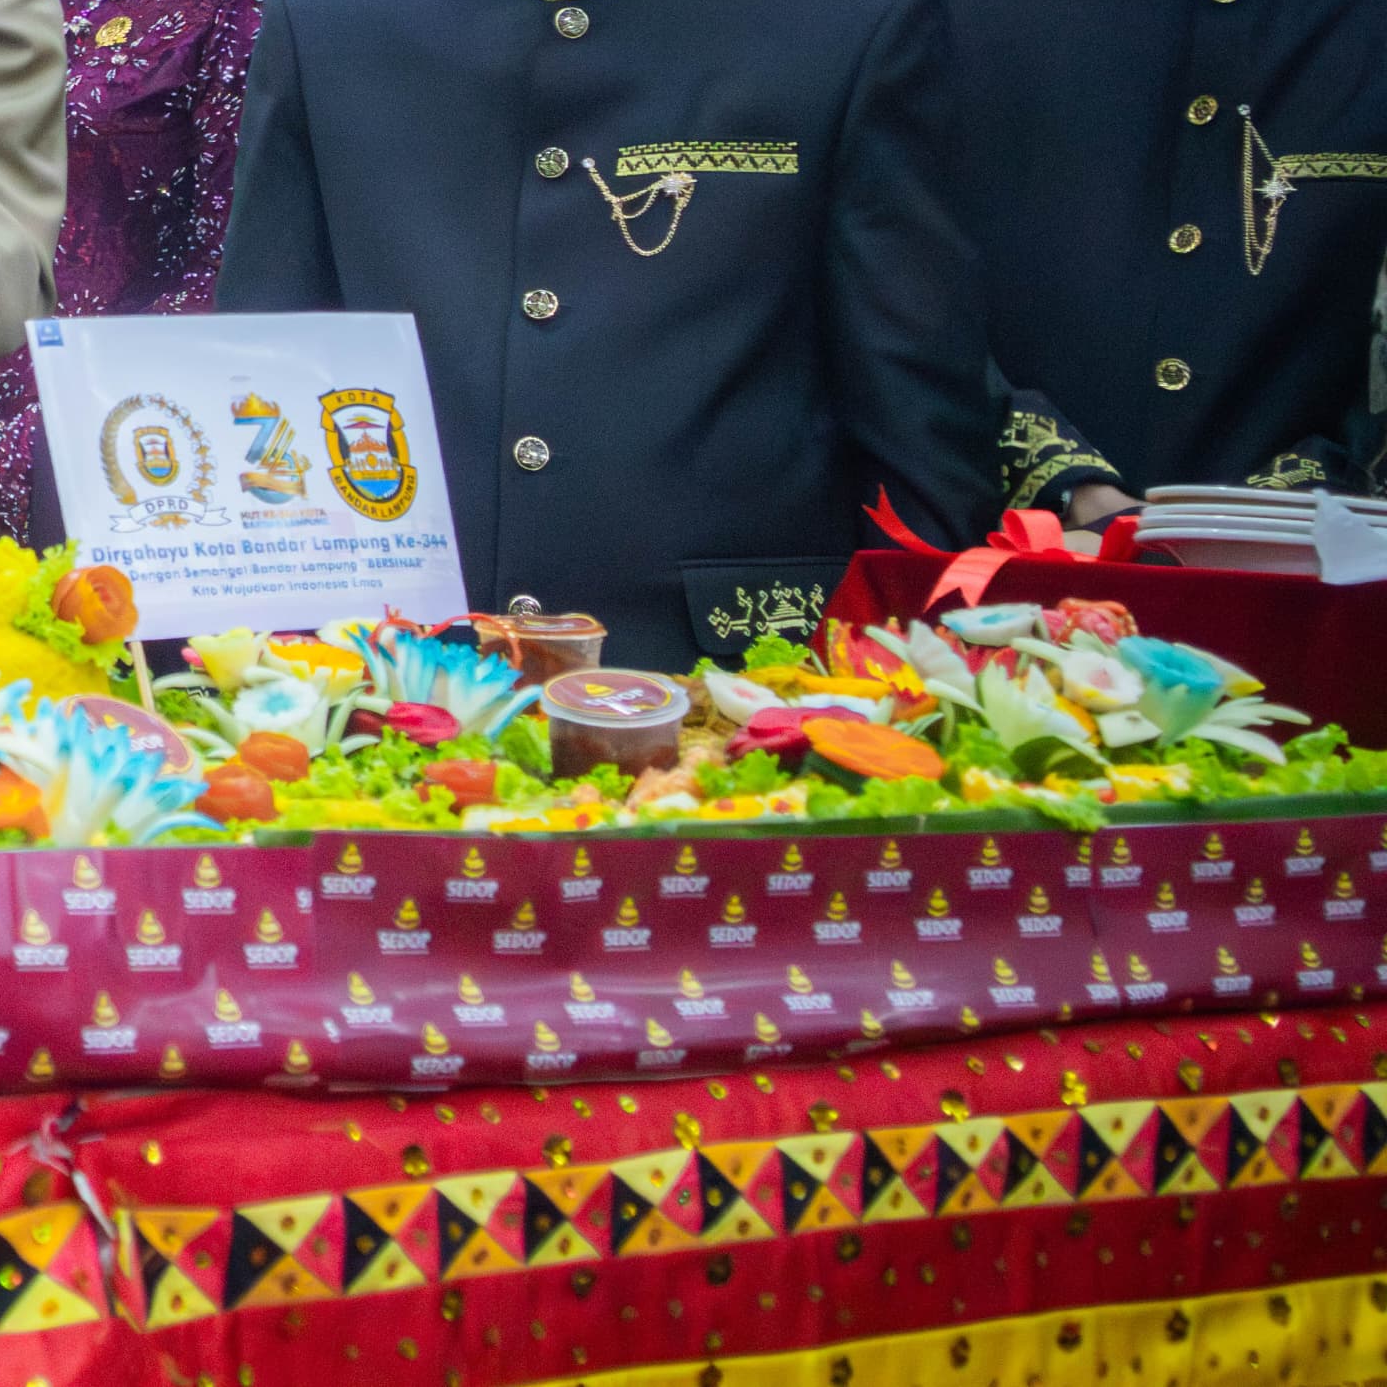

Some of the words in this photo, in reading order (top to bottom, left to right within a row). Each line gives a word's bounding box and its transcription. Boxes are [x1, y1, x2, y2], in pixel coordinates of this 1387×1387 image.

[335, 392, 380, 404] KOTA
[144, 497, 189, 514] DPRD
[92, 544, 189, 565] Dirgahayu
[194, 541, 236, 557] Kota
[241, 537, 306, 554] Bandar
[313, 536, 391, 554] Lampung
[395, 533, 448, 550] Ke-344
[129, 569, 181, 583] Dengan
[252, 563, 297, 575] Bandar
[302, 560, 358, 574] Lampung
[321, 875, 377, 897] SEDOP
[659, 876, 710, 896] SEDOP
[767, 873, 814, 893] SEDOP
[865, 870, 913, 889] SEDOP
[967, 867, 1014, 887] SEDOP
[182, 888, 236, 911] SEDOP
[445, 880, 499, 900] SEDOP
[602, 928, 651, 948] SEDOP
[709, 925, 757, 944] SEDOP
[813, 921, 862, 941] SEDOP
[915, 919, 963, 938] SEDOP
[377, 929, 431, 951] SEDOP
[493, 931, 546, 951] SEDOP
[126, 944, 182, 967] SEDOP
[243, 943, 298, 966] SEDOP
